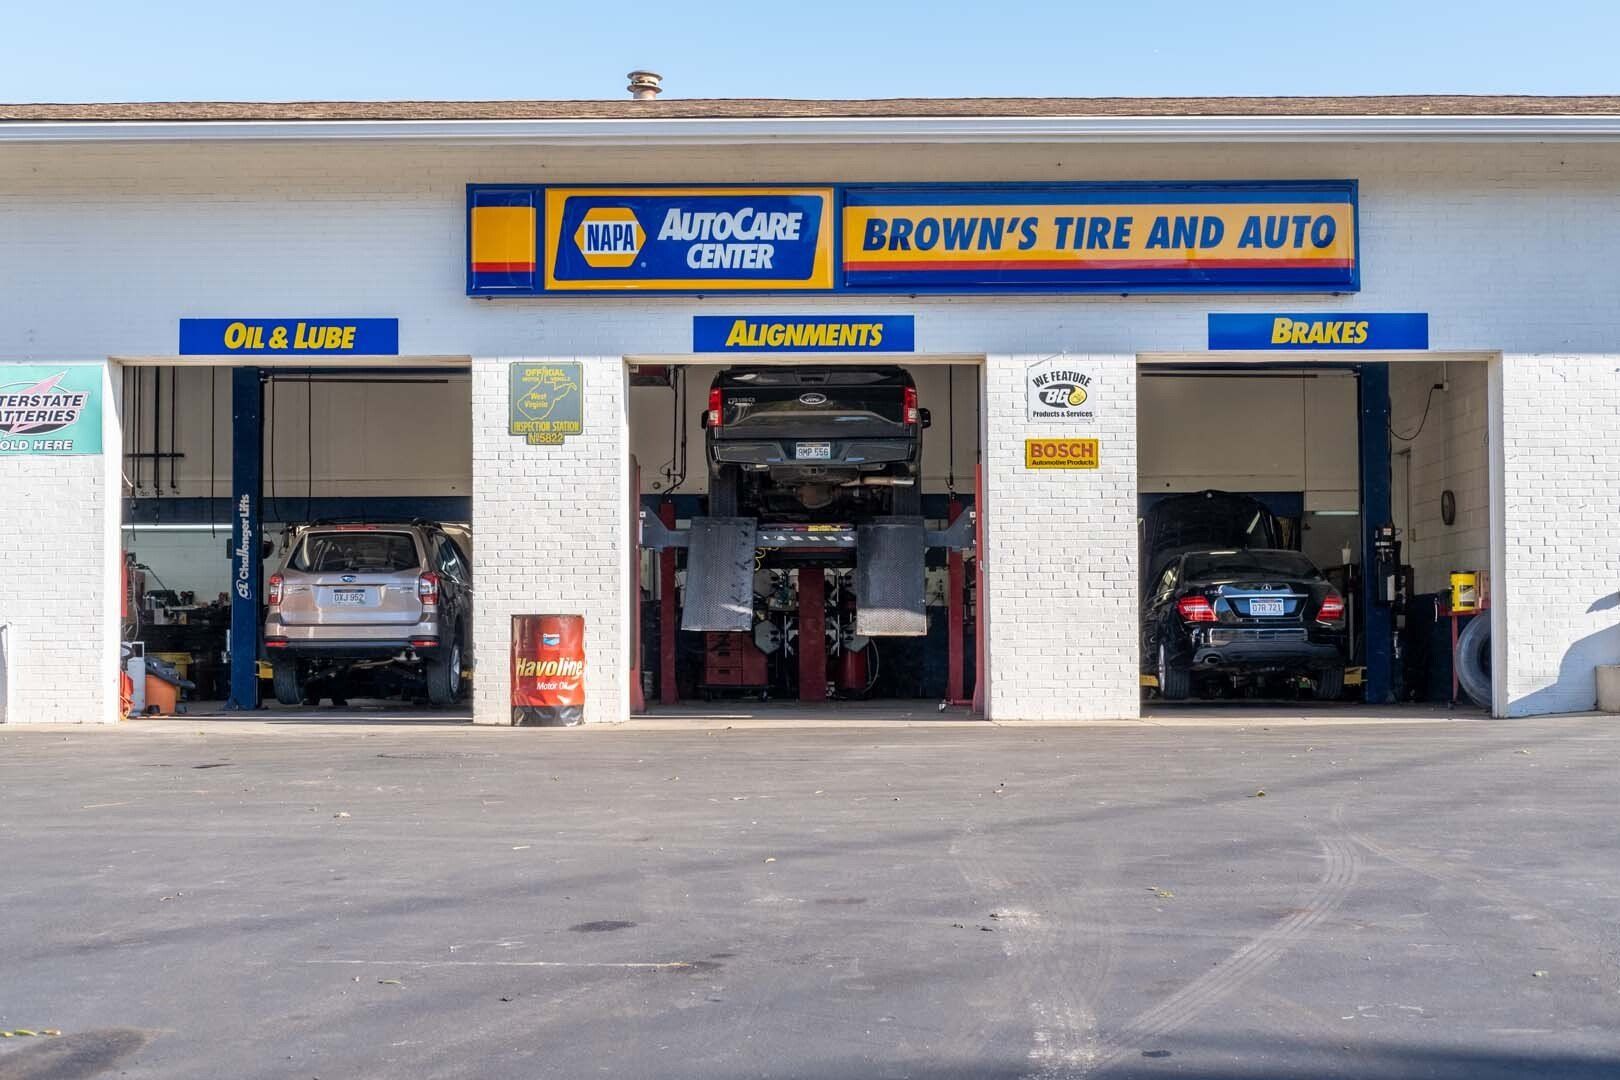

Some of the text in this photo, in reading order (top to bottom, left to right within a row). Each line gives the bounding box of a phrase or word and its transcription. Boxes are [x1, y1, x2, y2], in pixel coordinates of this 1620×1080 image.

[657, 207, 803, 241] AUTOCARE
[862, 214, 1337, 251] BROWN'S TIRE AND AUTO
[587, 223, 635, 252] NAPA
[686, 243, 774, 269] CENTER
[223, 321, 357, 350] OIL & LUBE
[724, 319, 884, 347] ALIGNMENTS
[1271, 317, 1369, 344] BRAKES
[1032, 370, 1093, 388] WE FEATURE
[1044, 387, 1071, 404] BG
[0, 410, 77, 422] TTERIES
[1032, 410, 1060, 418] Products
[1066, 410, 1093, 418] Services
[513, 421, 580, 433] INSPECTION STATION
[32, 439, 74, 451] HERE
[1030, 442, 1094, 458] BOSCH
[239, 494, 250, 518] Lifts
[235, 518, 252, 580] Challenger
[516, 656, 583, 680] Havoline
[536, 681, 558, 690] Motor
